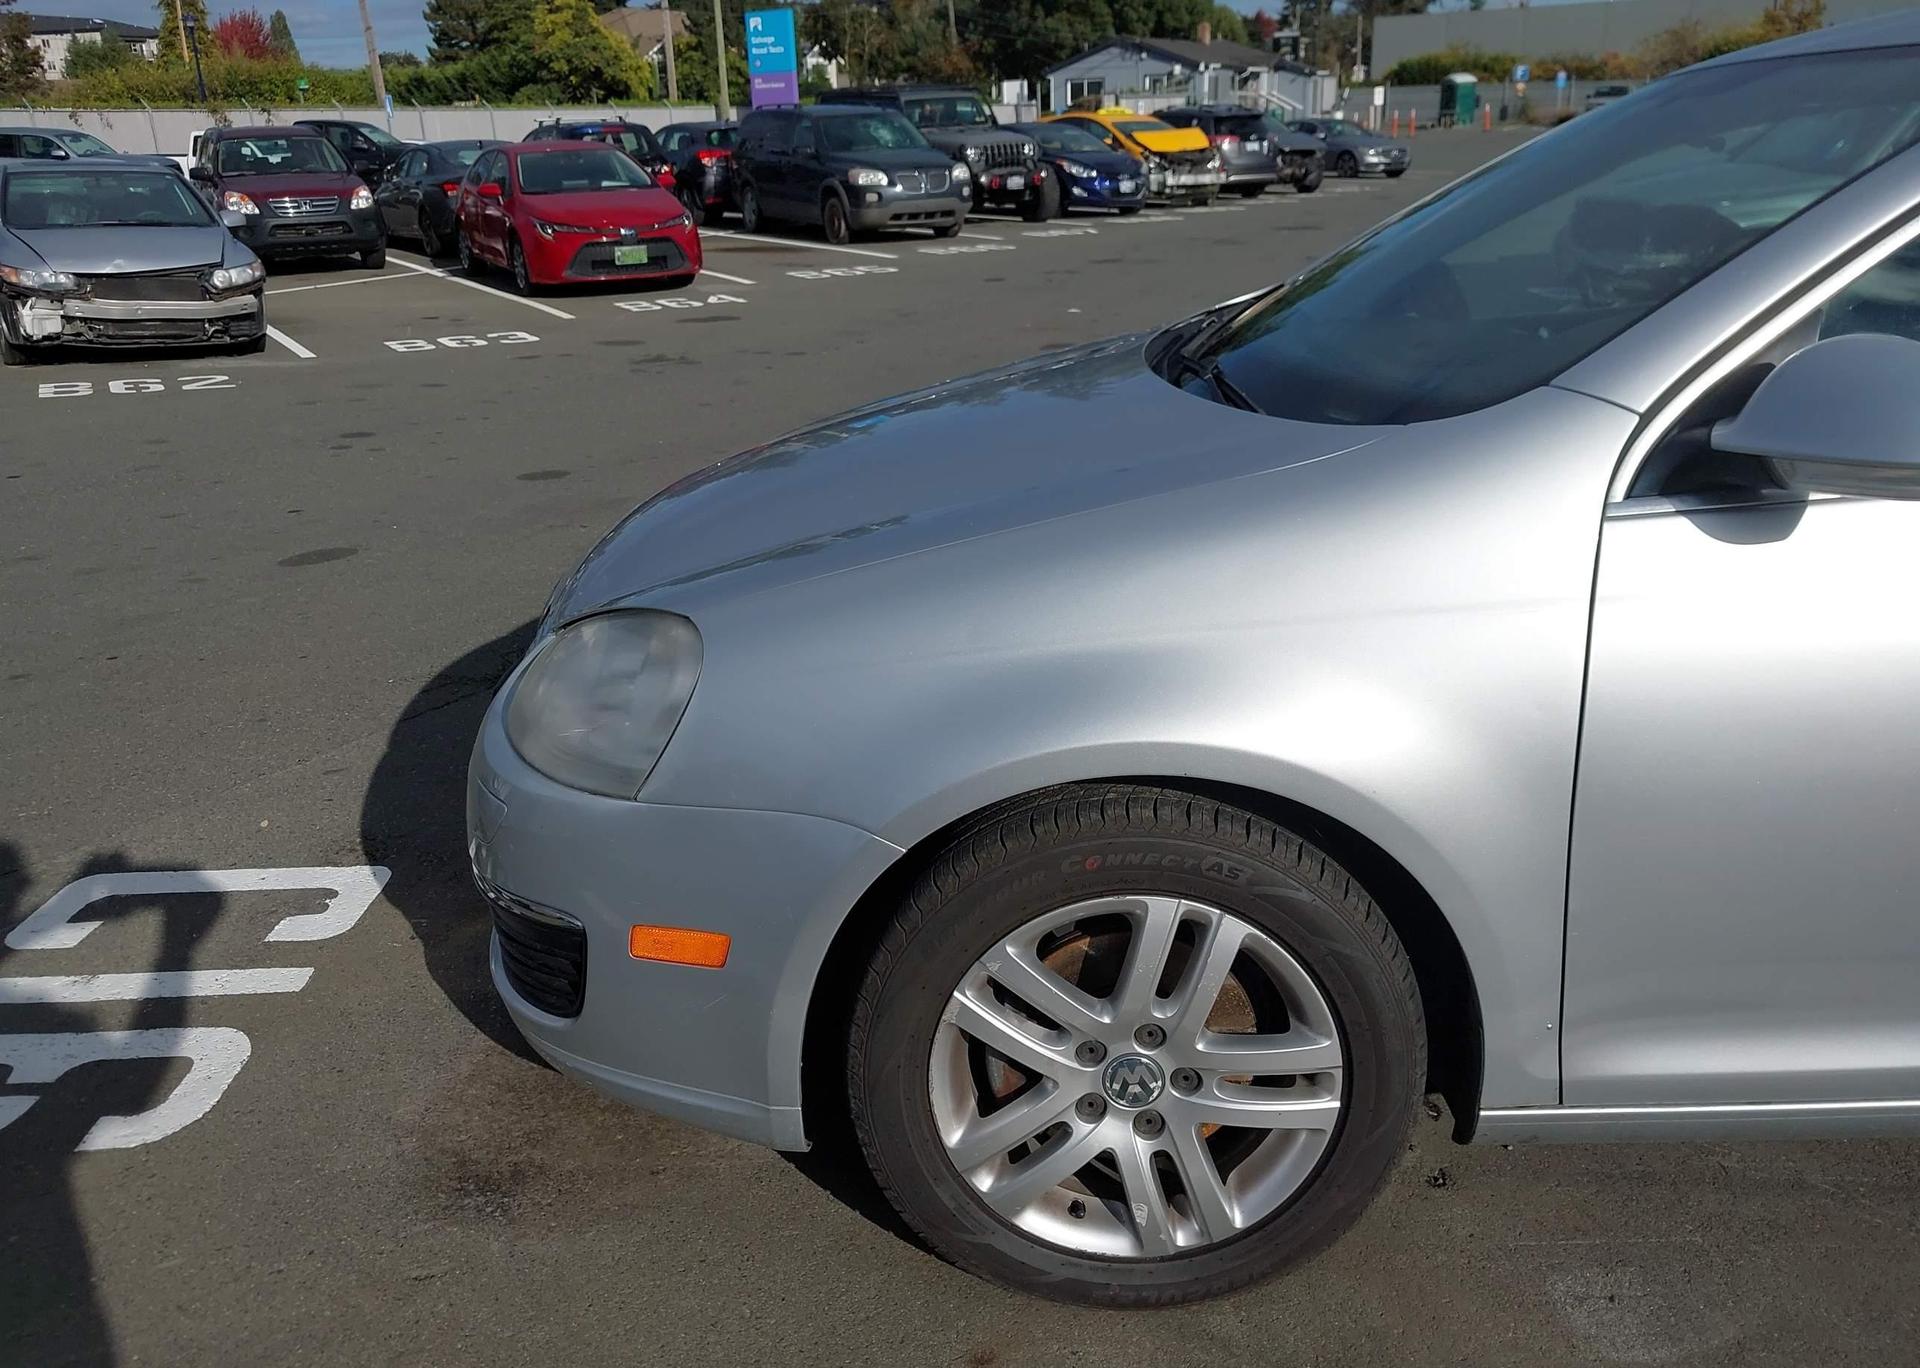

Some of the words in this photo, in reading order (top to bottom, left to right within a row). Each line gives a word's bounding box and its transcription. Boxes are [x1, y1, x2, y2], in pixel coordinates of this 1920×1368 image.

[614, 294, 748, 313] B64
[384, 331, 541, 353] B63
[38, 375, 237, 399] B62
[1061, 854, 1201, 874] CONNECT
